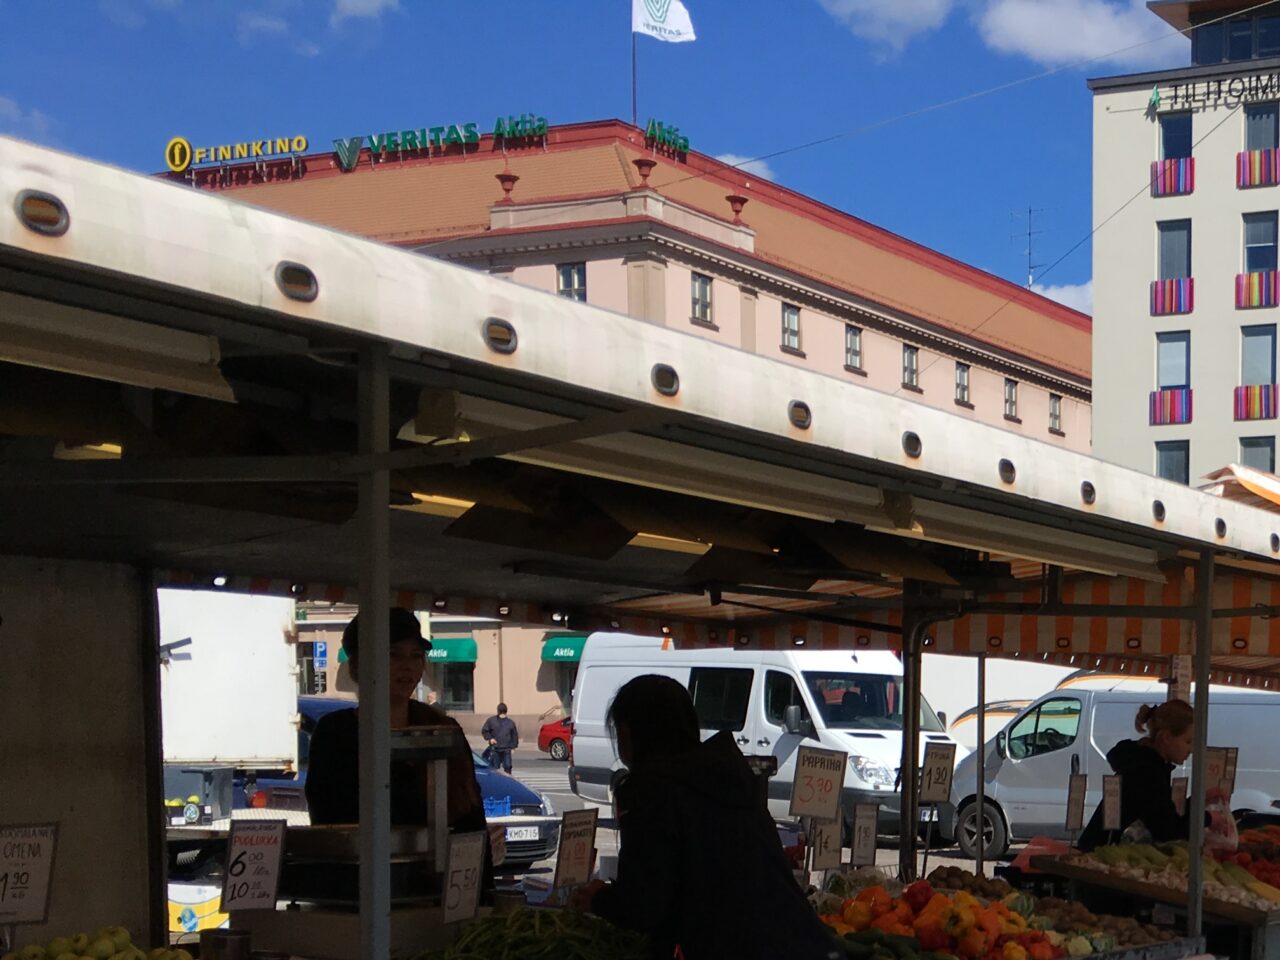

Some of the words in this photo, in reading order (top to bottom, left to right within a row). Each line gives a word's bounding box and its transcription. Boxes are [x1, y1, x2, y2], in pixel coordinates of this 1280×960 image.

[493, 113, 548, 139] Aktia
[646, 118, 690, 154] Aktia
[194, 135, 308, 164] FINNKINO
[367, 122, 480, 155] VERITAS
[317, 642, 326, 657] P
[428, 649, 448, 658] Aktia
[553, 648, 575, 657] Aktia
[230, 851, 247, 877] 6
[13, 871, 30, 885] 90
[228, 882, 249, 902] 10
